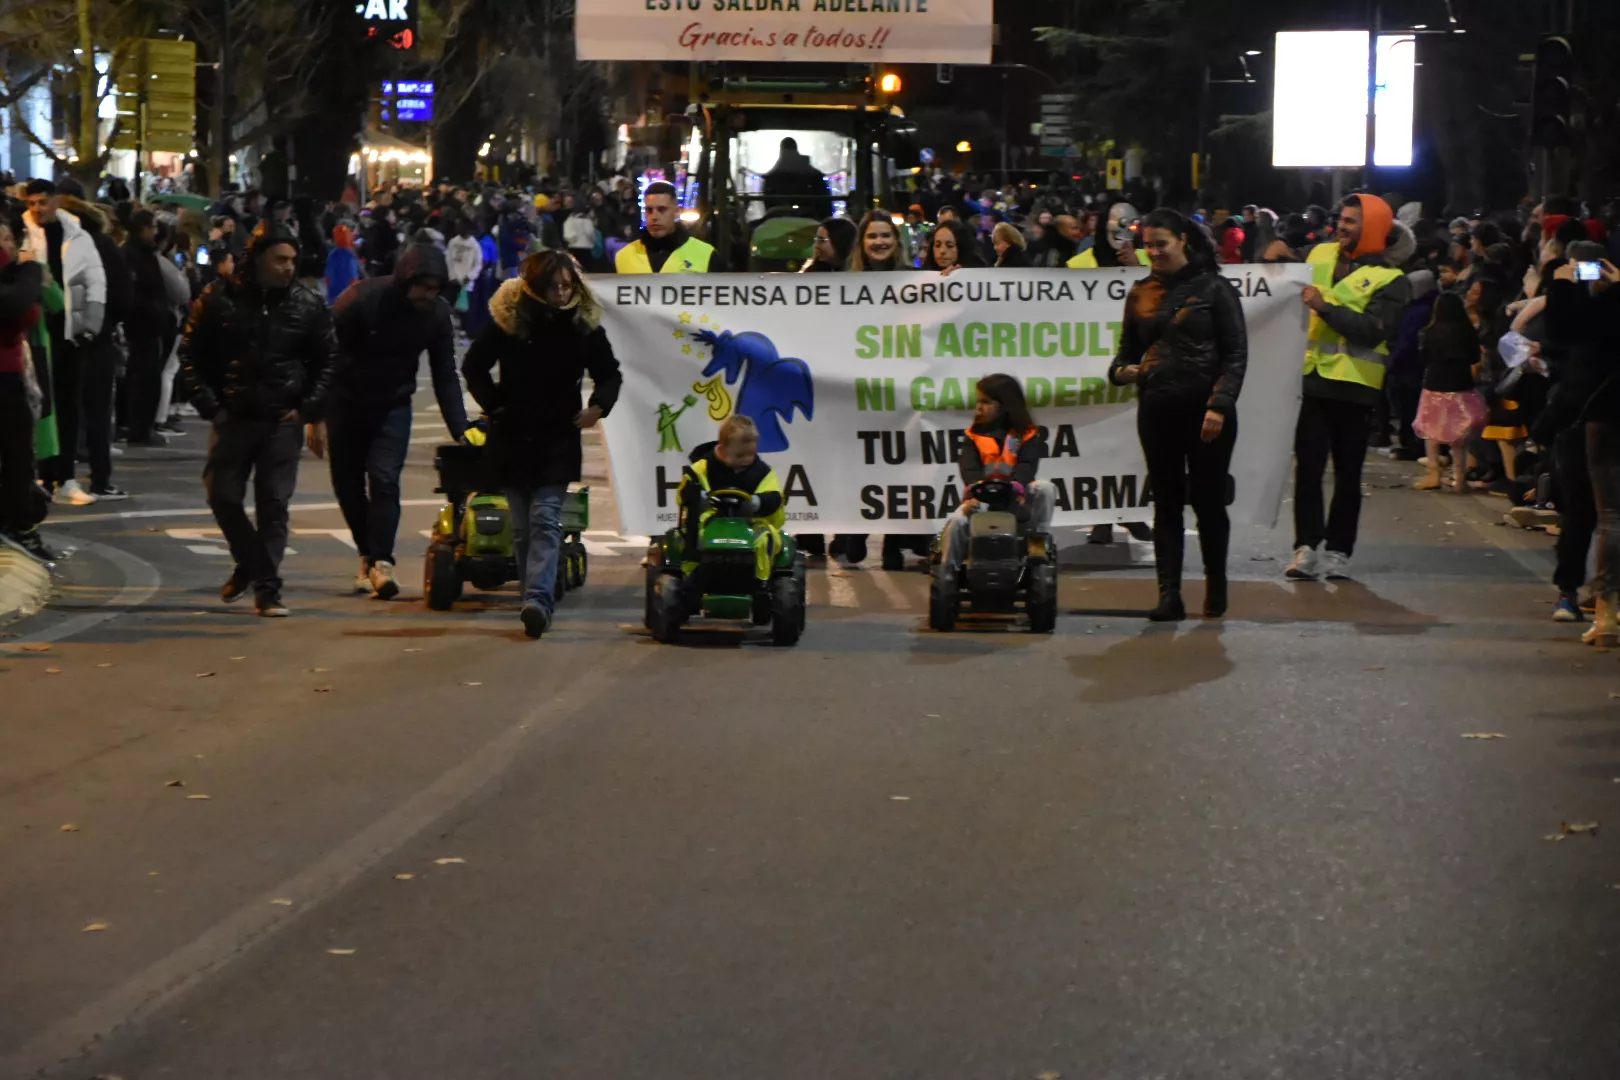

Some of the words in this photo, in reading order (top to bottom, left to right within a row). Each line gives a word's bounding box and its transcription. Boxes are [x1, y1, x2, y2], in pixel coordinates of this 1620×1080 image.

[813, 0, 928, 12] ADELANTE
[617, 285, 651, 305] EN
[661, 286, 787, 306] DEFENSA
[796, 285, 830, 305] DE
[840, 285, 874, 305] LA
[881, 280, 1073, 305] AGRICULTURA
[1081, 280, 1099, 301] Y
[855, 324, 922, 359] SIN
[935, 321, 1123, 358] AGRICULT
[855, 377, 895, 411] NI
[857, 429, 907, 465] TU
